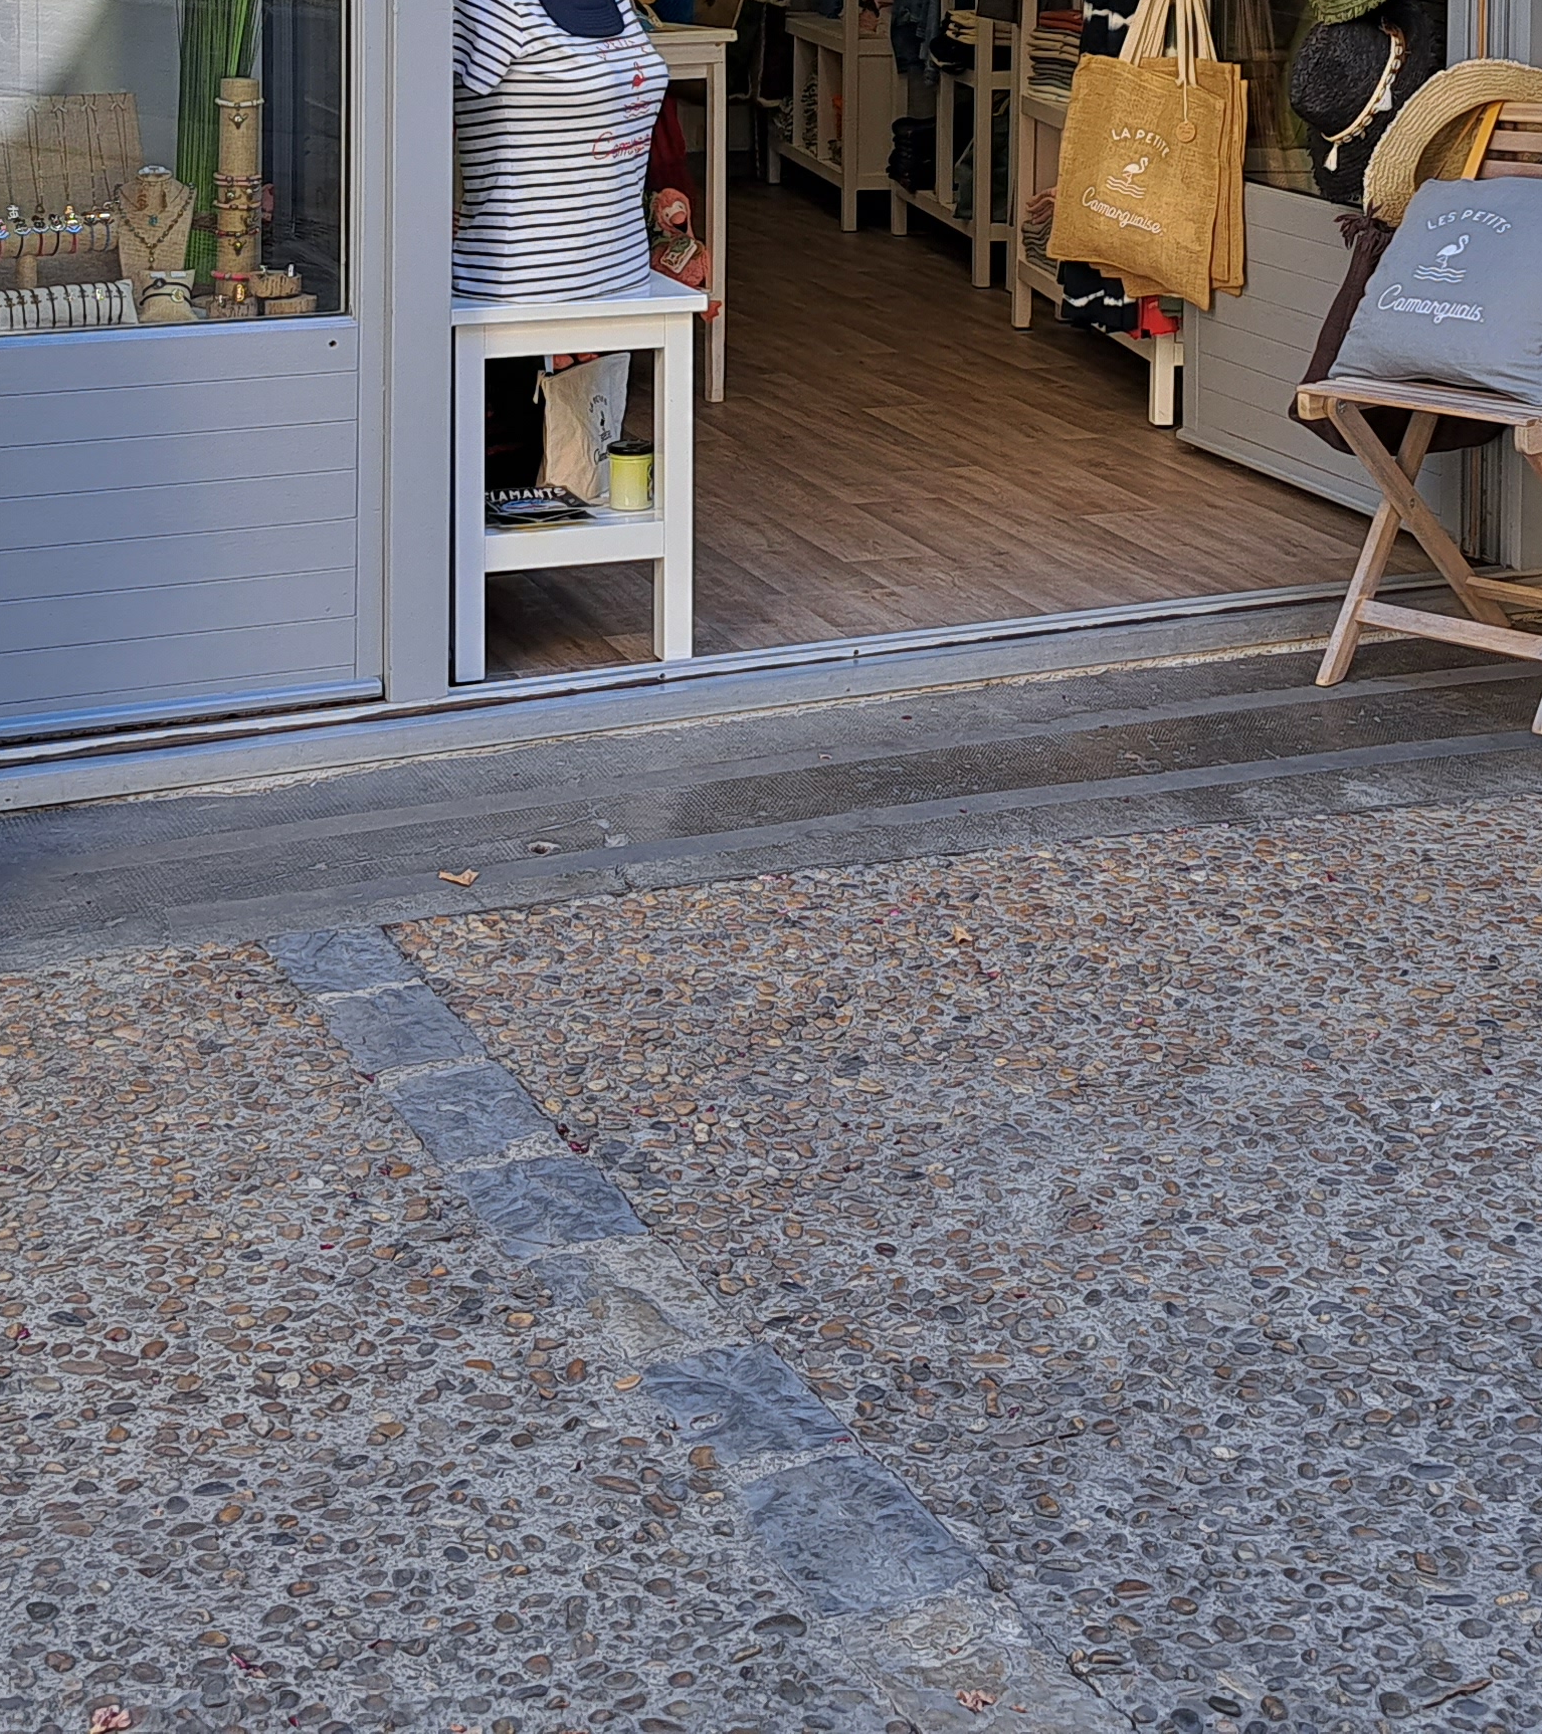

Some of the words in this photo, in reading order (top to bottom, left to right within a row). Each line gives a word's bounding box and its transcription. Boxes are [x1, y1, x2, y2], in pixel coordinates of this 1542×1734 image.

[1111, 127, 1131, 141] LA
[1135, 129, 1170, 158] PETITE
[1427, 210, 1456, 231] LES
[1461, 209, 1512, 234] PETITS
